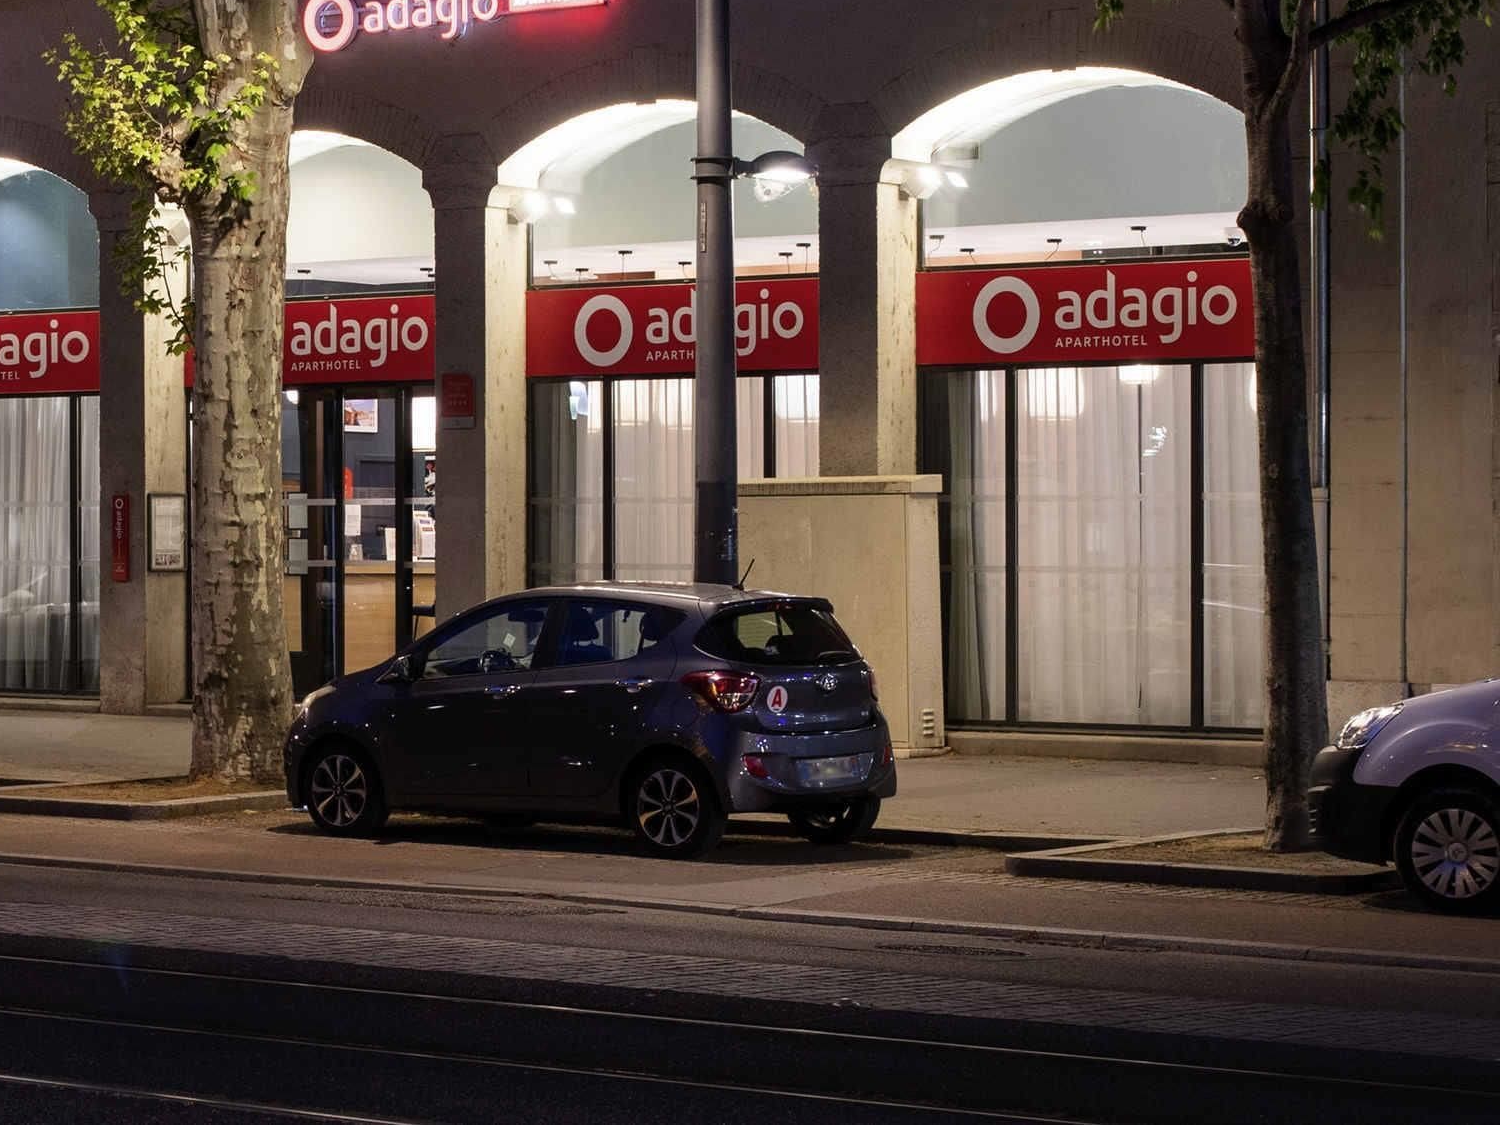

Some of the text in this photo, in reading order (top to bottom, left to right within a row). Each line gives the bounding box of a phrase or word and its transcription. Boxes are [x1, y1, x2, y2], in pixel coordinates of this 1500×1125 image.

[1054, 269, 1237, 344] adagio
[645, 288, 804, 356] adgio
[290, 303, 429, 368] adagio
[1055, 335, 1148, 348] APARTHOTEL
[291, 359, 361, 372] APARTHOTEL
[646, 349, 696, 362] APARTH
[771, 686, 782, 708] A
